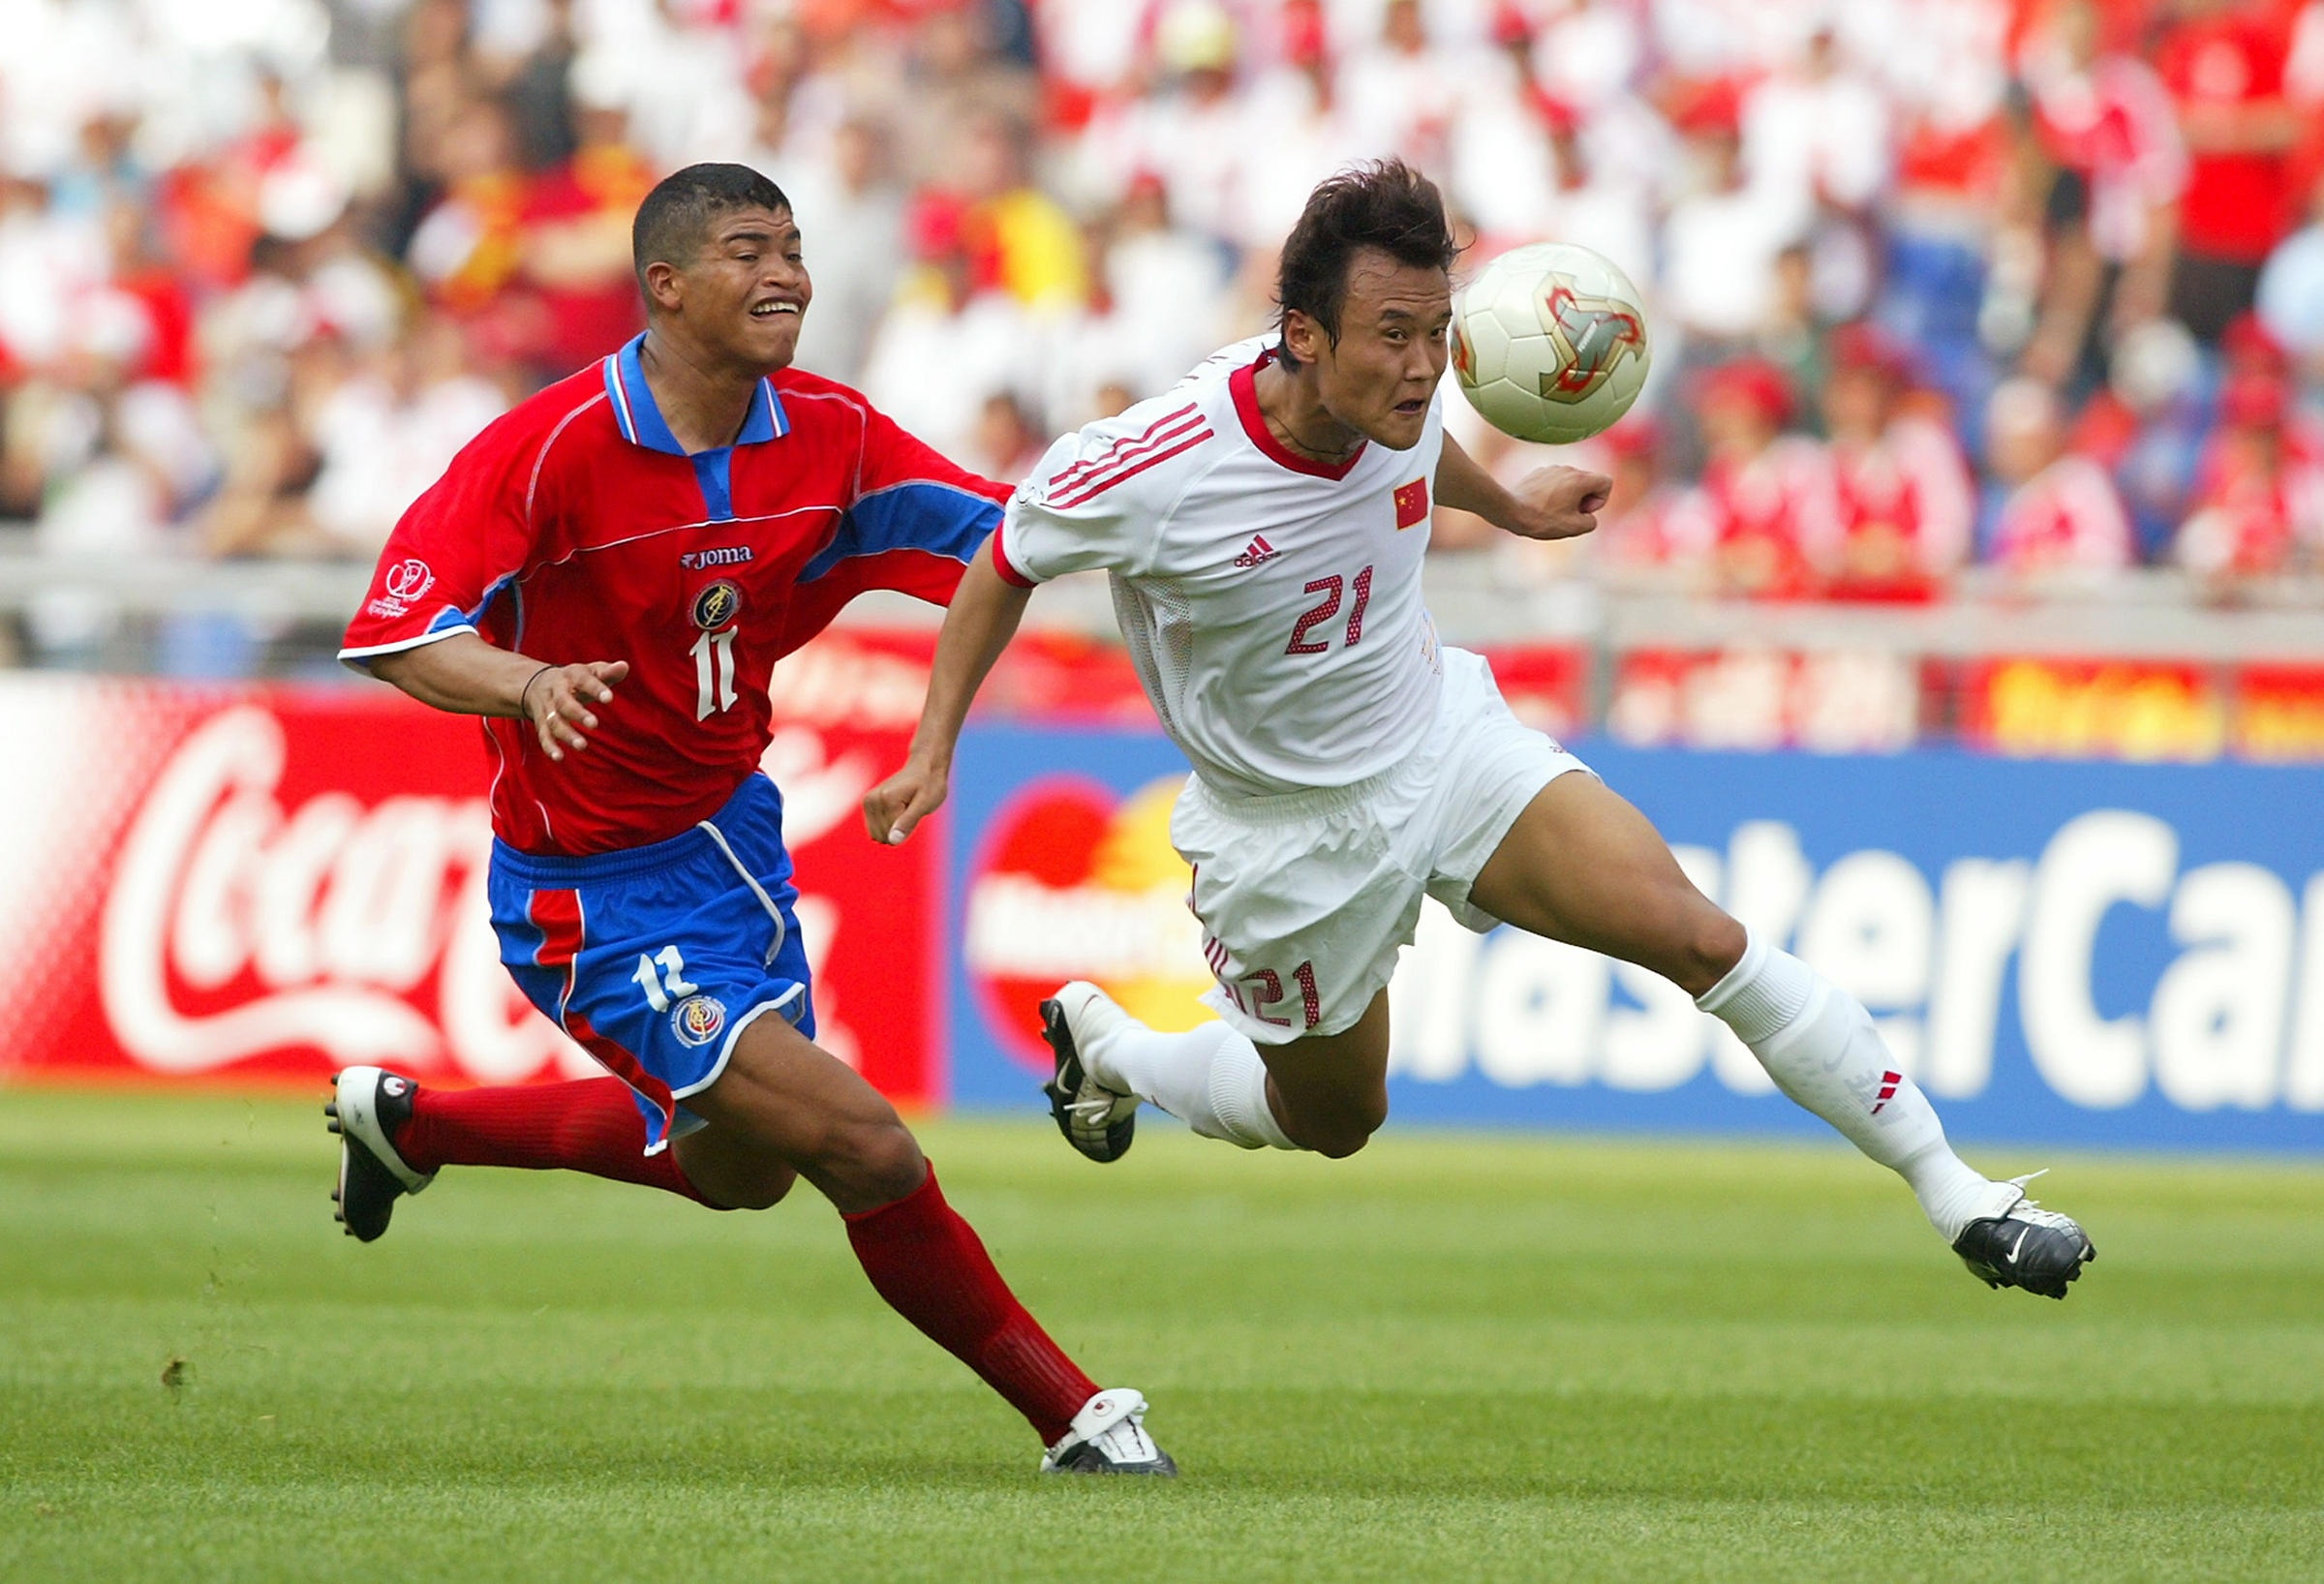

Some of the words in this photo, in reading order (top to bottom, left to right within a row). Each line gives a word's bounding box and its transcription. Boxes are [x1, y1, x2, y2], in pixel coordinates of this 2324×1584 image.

[1284, 564, 1373, 655] 21
[688, 625, 739, 722] 11
[1239, 960, 1321, 1029] 21
